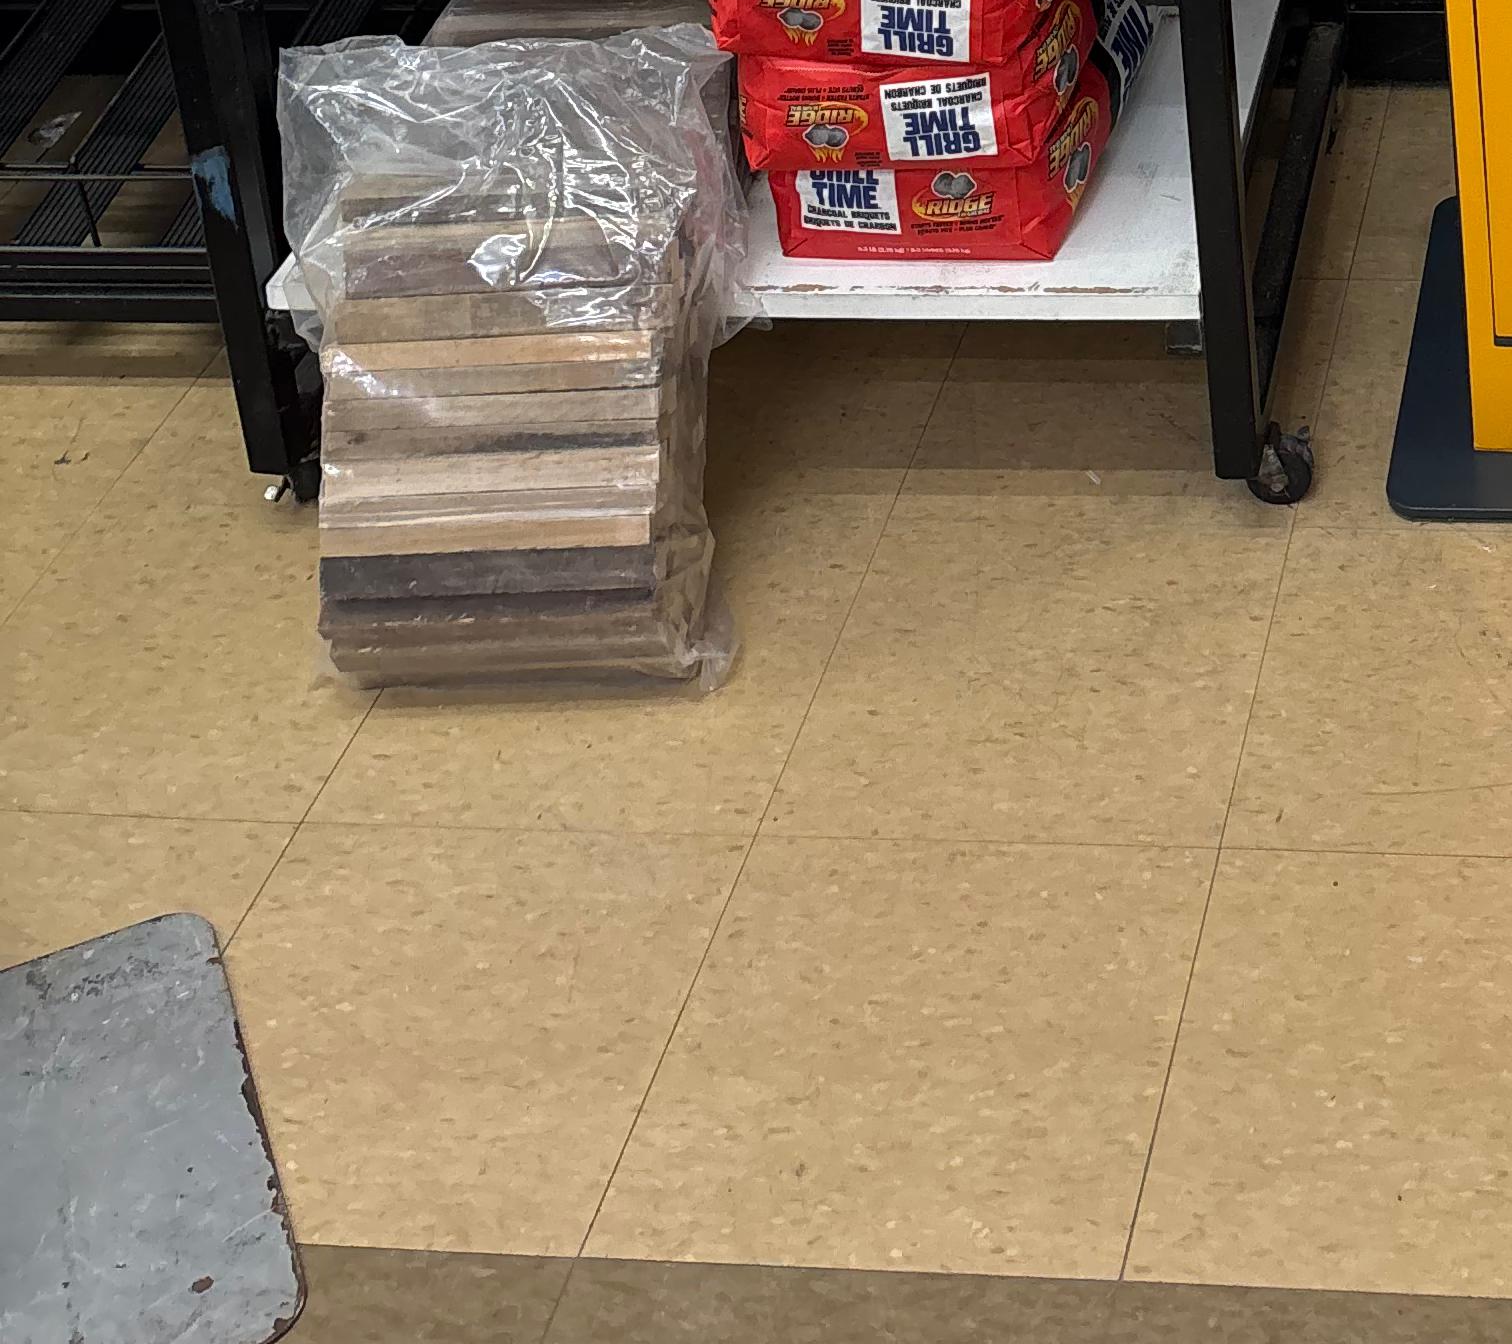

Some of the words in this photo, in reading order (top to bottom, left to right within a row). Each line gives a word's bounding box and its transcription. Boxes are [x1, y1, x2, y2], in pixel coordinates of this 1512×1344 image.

[880, 6, 947, 34] TIME
[878, 28, 953, 57] GRILL
[786, 111, 854, 127] RIDGE
[903, 107, 974, 135] TIME
[903, 130, 980, 157] GRILL
[812, 182, 881, 209] TIME
[927, 195, 993, 215] RIDGE
